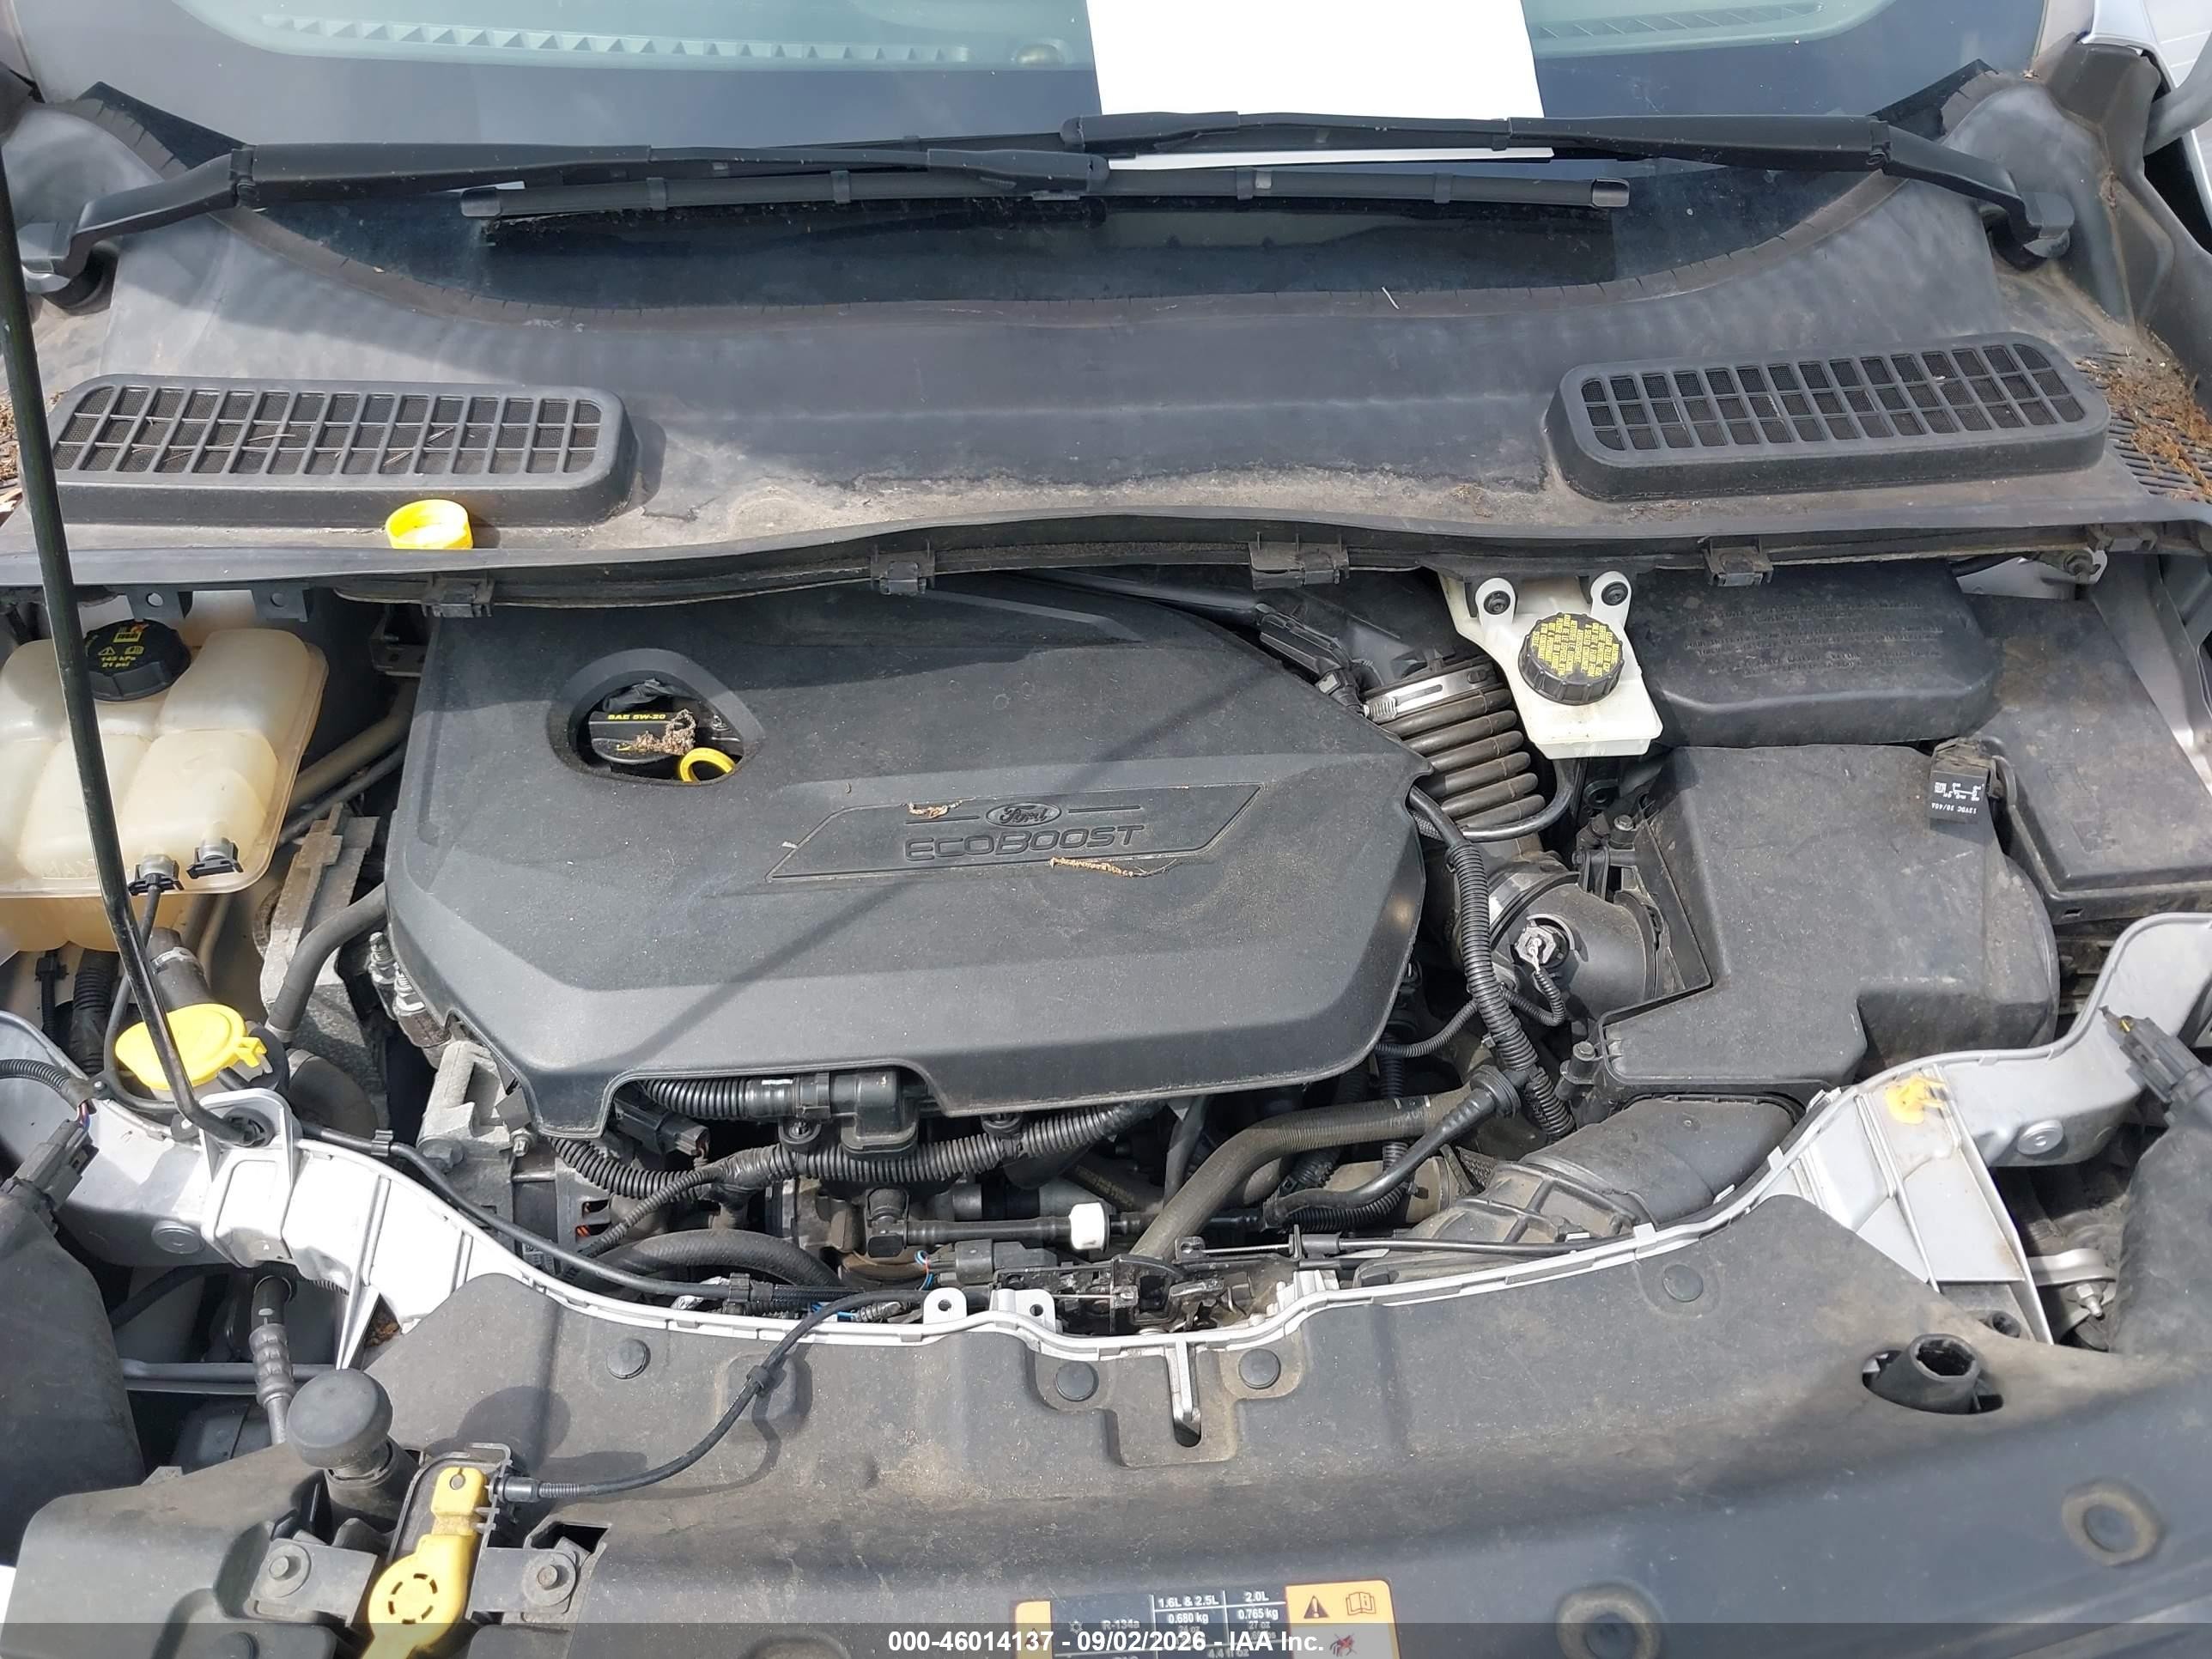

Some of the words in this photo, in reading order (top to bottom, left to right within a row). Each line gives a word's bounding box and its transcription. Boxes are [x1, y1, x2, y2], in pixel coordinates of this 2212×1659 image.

[998, 804, 1049, 825] Ford
[905, 824, 1145, 862] ECOBOOST
[1159, 1597, 1182, 1608] 1.6L
[1183, 1597, 1193, 1607] &
[1194, 1595, 1218, 1606] 2.5L
[1244, 1591, 1269, 1602] 2.0L
[1169, 1613, 1194, 1624] 0.680
[1195, 1613, 1209, 1625] kg
[1237, 1608, 1264, 1620] 0.765
[1266, 1607, 1279, 1620] kg
[1101, 1619, 1140, 1631] R-134a
